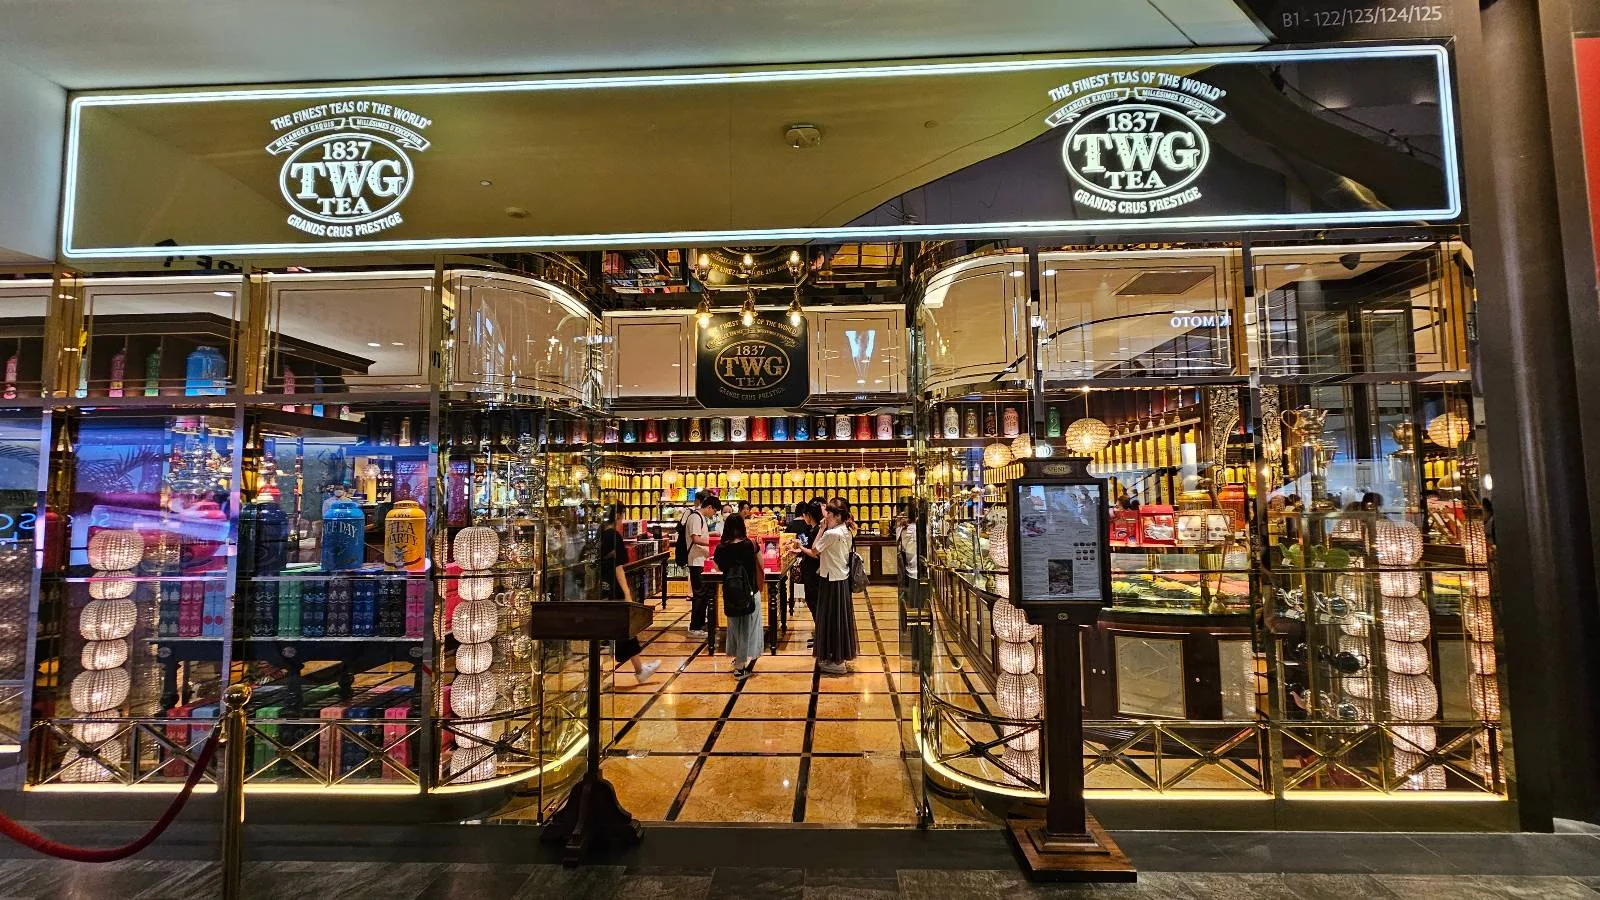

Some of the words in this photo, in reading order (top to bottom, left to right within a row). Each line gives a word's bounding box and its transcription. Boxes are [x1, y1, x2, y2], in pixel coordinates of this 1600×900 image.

[1282, 12, 1299, 28] B1
[1313, 5, 1442, 27] 122/123/124/125
[1048, 87, 1072, 102] THE
[1073, 74, 1110, 96] FINEST
[1111, 71, 1140, 83] TEAS
[1142, 72, 1156, 83] OF
[1157, 73, 1180, 87] THE
[271, 115, 292, 131] THE
[292, 105, 328, 124] FINEST
[329, 101, 354, 114] TEAS
[356, 102, 370, 113] OF
[371, 102, 392, 116] THE
[1106, 111, 1160, 133] 1837
[322, 141, 372, 160] 1837
[1072, 131, 1200, 173] TWG
[290, 159, 404, 199] TWG
[1104, 170, 1166, 190] TEA
[317, 197, 372, 215] TEA
[1074, 189, 1117, 213] GRANDS
[1117, 201, 1147, 214] CRUS
[1149, 186, 1202, 213] PRESTIGE
[287, 214, 326, 237] GRANDS
[327, 225, 354, 238] CRUS
[355, 212, 403, 236] PRESTIGE
[736, 345, 766, 356] 1837
[720, 356, 785, 377] TWG
[735, 377, 766, 387] TEA
